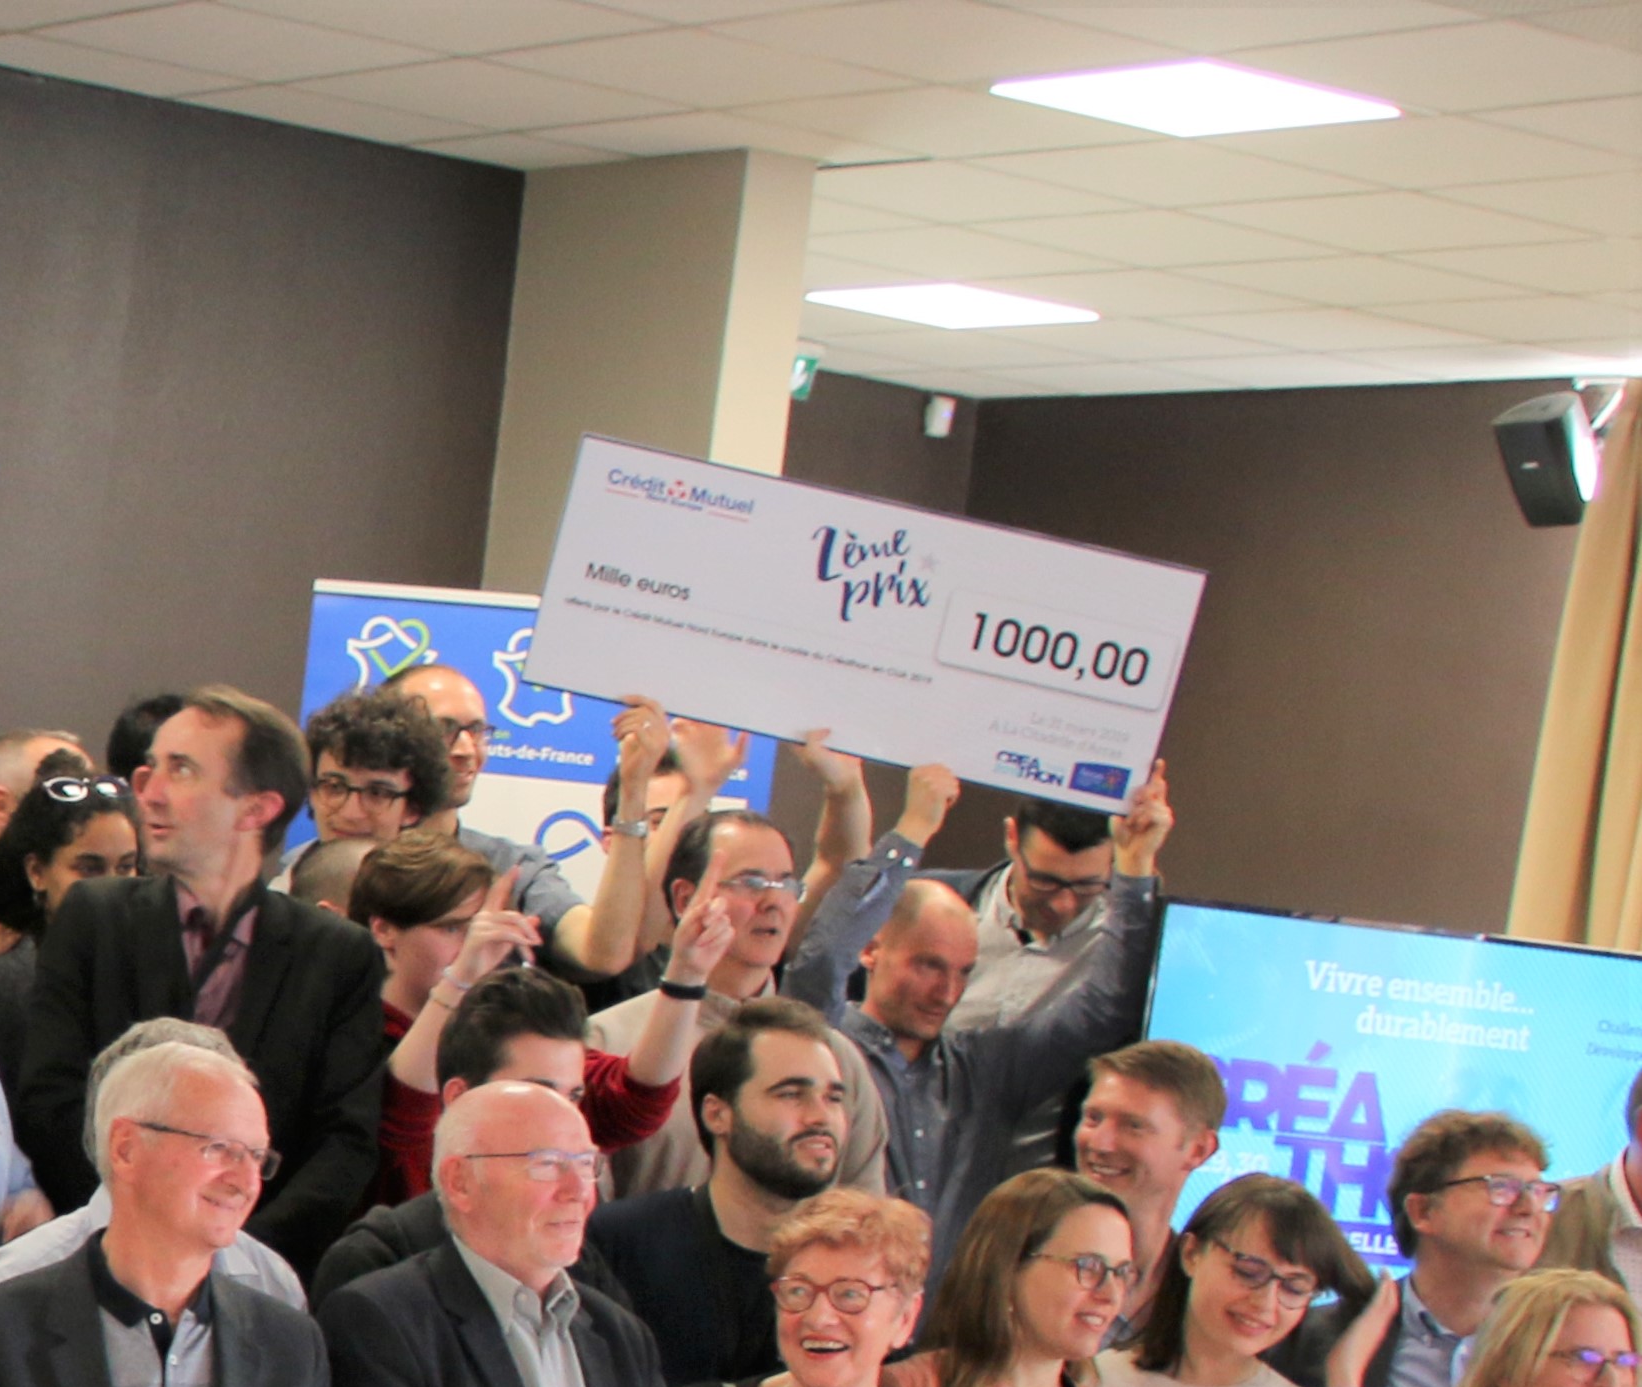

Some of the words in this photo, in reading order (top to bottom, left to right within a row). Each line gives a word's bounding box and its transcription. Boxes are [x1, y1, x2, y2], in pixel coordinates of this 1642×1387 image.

[607, 468, 666, 497] Crédit
[689, 486, 756, 515] Mutuel
[585, 562, 633, 588] Mille
[637, 577, 692, 602] euros
[839, 560, 932, 622] prix
[971, 611, 1150, 687] 1000,00
[486, 743, 595, 766] uts-de-France
[1305, 959, 1384, 998] Vivre
[1386, 977, 1535, 1016] ensemble...
[1355, 1005, 1531, 1052] durablement
